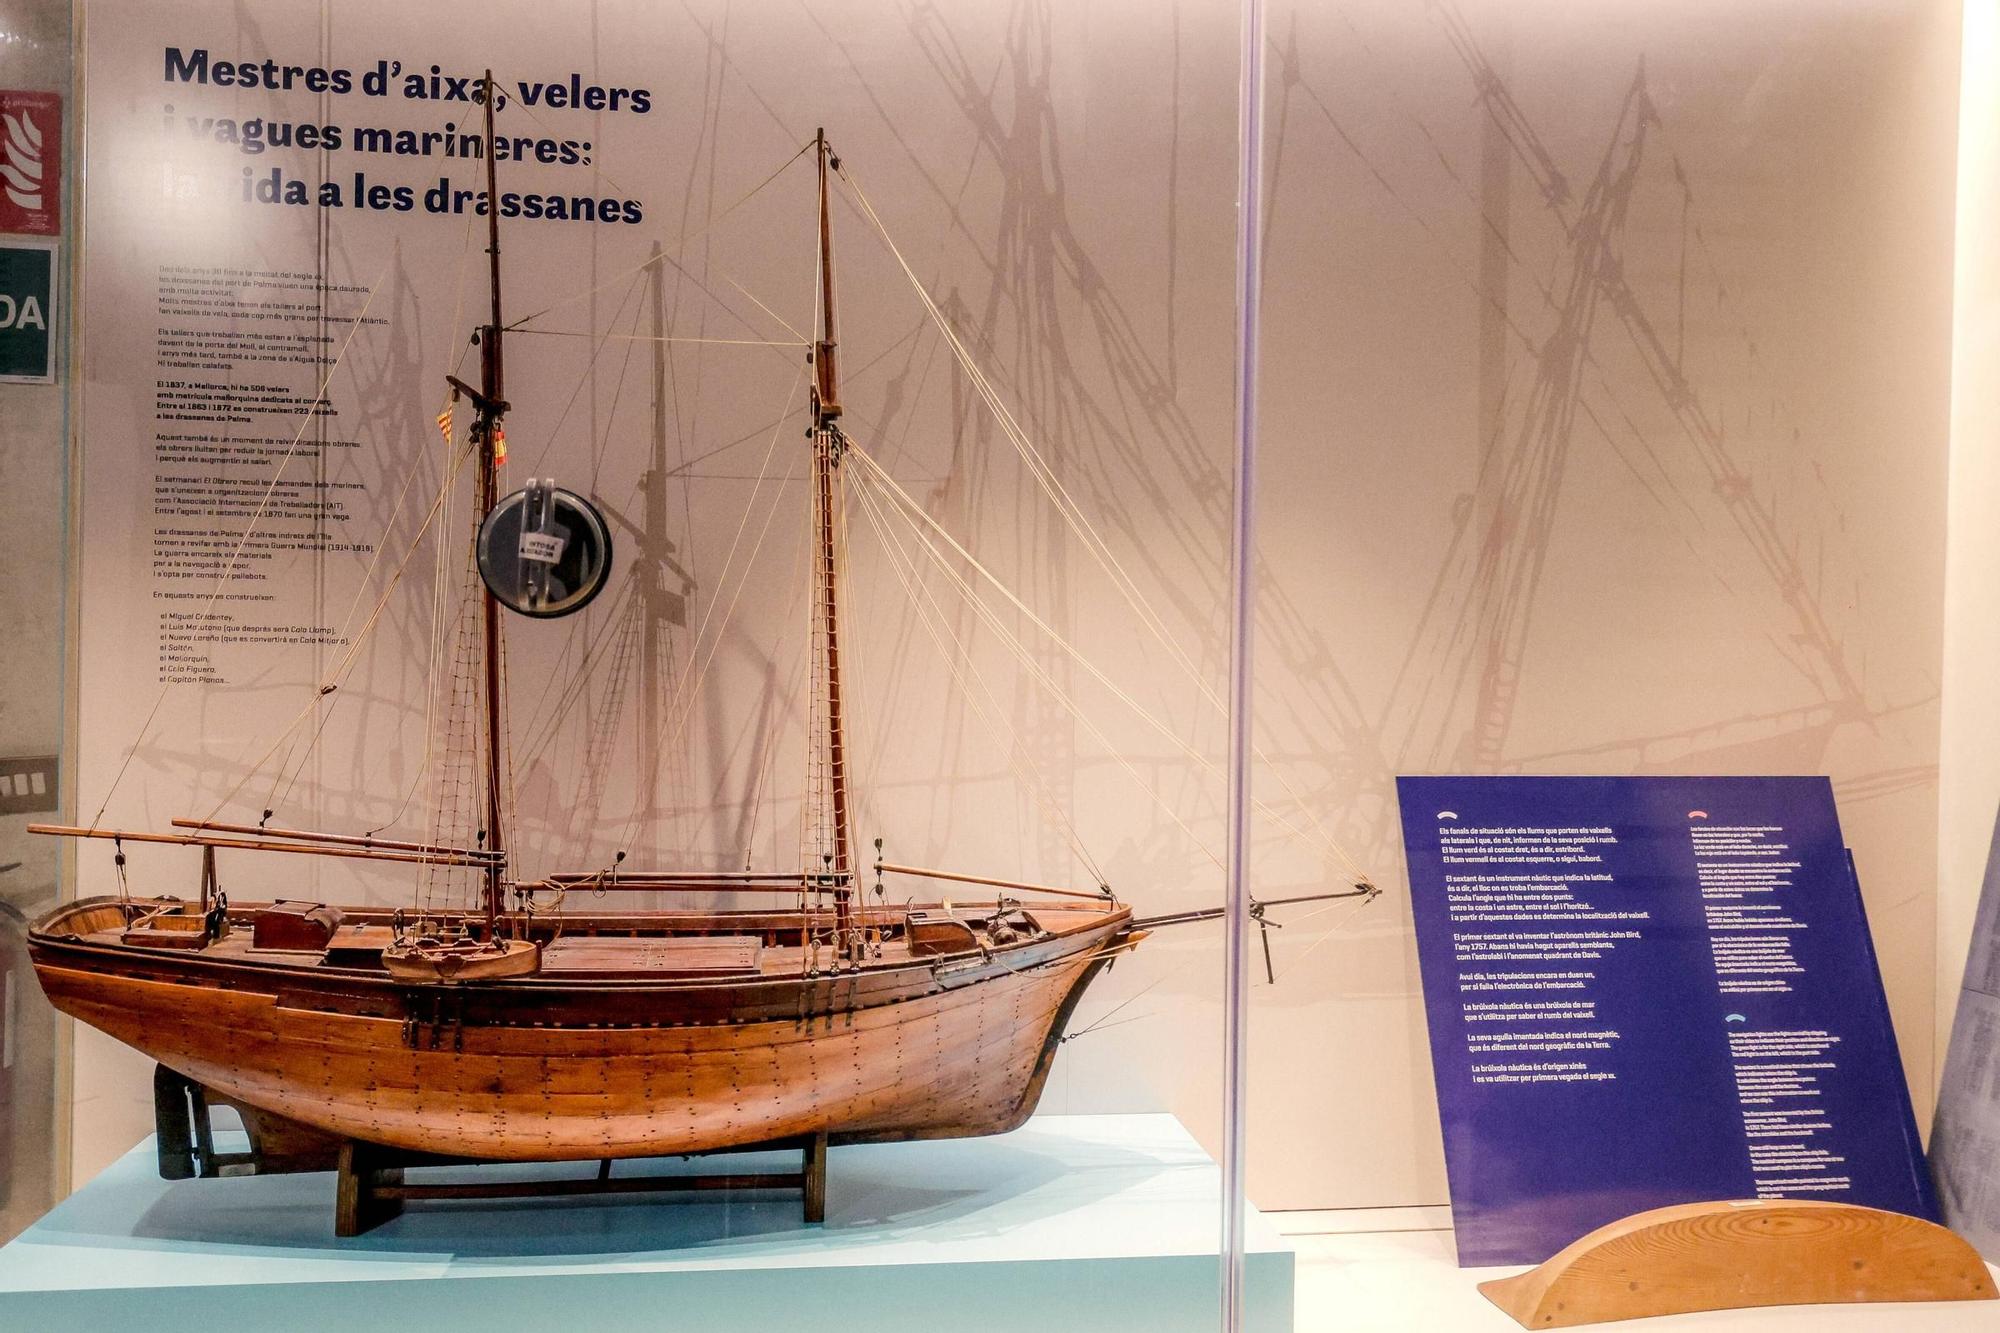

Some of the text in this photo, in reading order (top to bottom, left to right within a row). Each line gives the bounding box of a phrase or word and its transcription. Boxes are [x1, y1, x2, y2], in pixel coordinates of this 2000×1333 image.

[164, 46, 353, 93] Mestres
[517, 73, 653, 115] velers
[186, 116, 343, 155] vagues
[353, 122, 592, 166] marineres:
[225, 166, 307, 206] ida
[319, 180, 343, 208] a
[354, 172, 414, 212] les
[424, 177, 644, 225] drassanes
